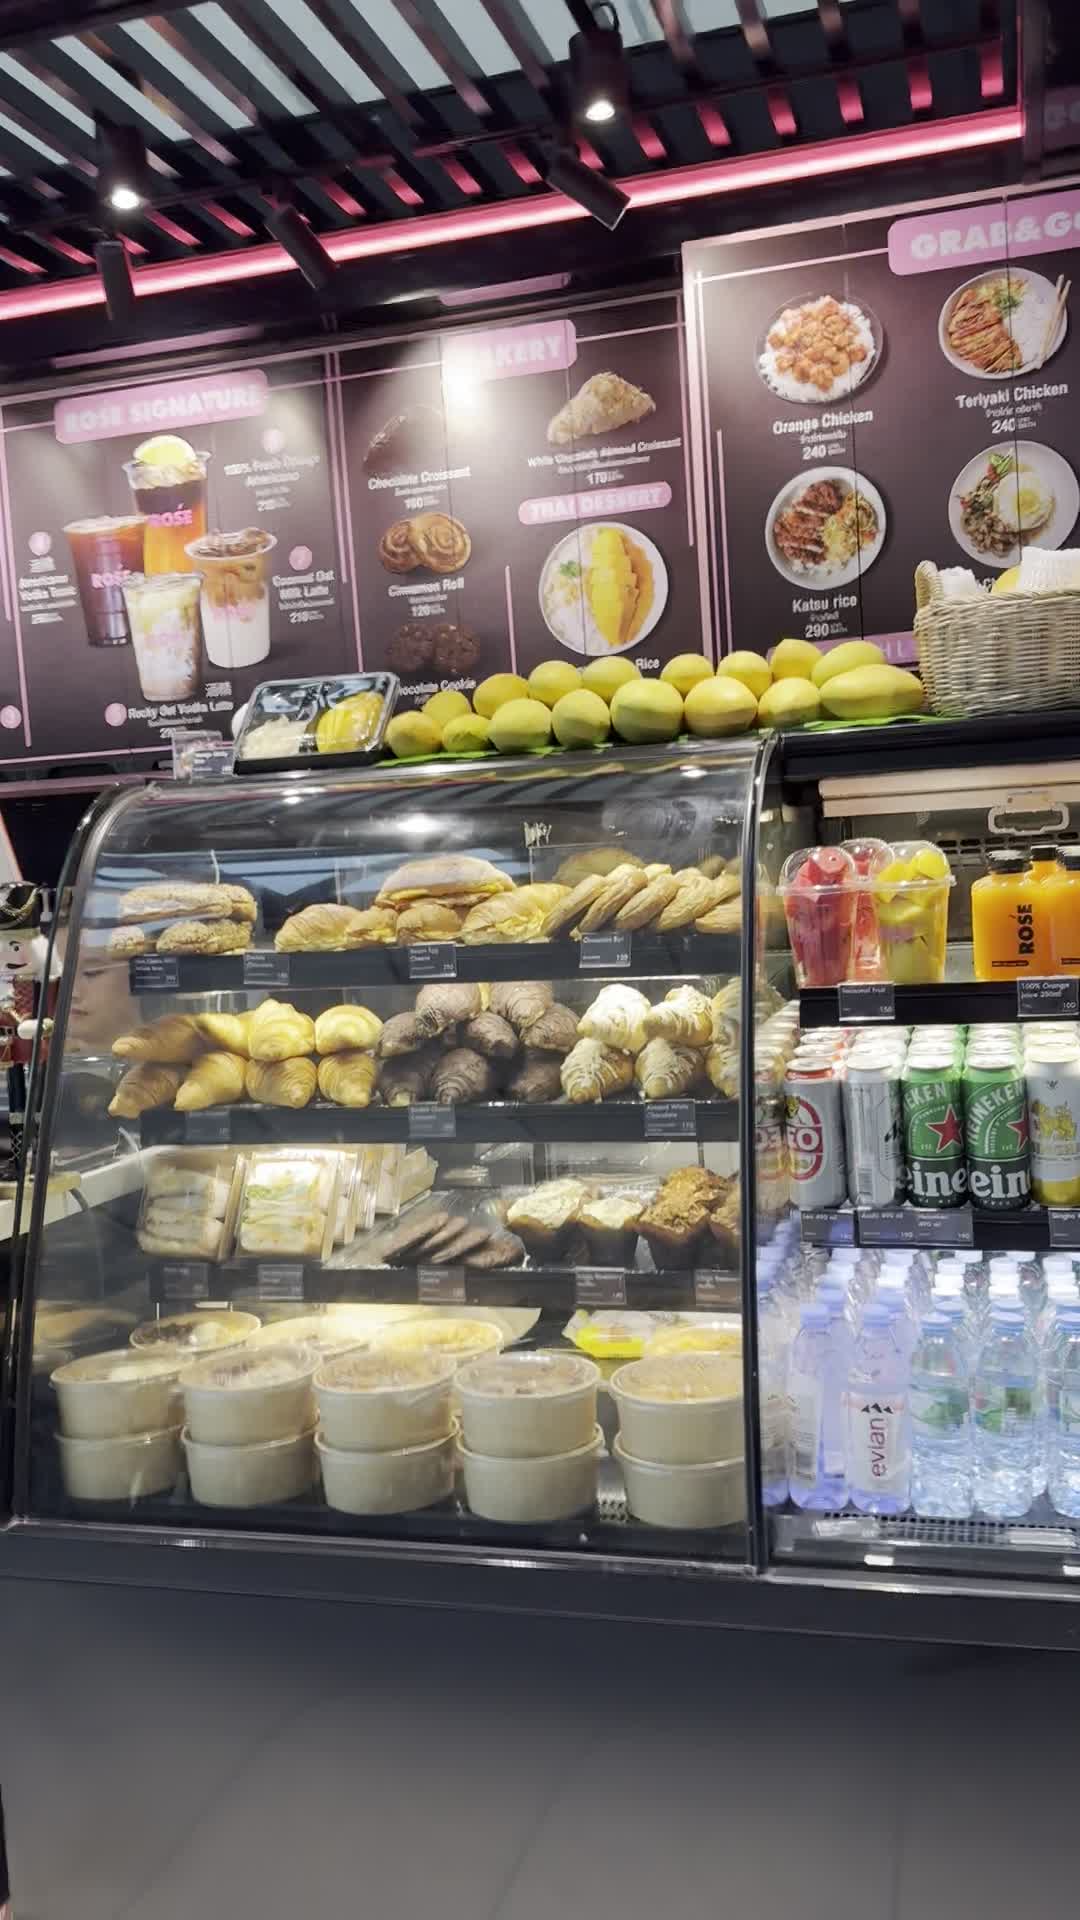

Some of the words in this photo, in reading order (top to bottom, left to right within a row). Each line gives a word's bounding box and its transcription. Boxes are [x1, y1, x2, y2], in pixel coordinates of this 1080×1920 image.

[494, 336, 560, 368] KERY
[128, 384, 260, 424] SIGNATURE
[955, 388, 1009, 408] Teriyaki
[1014, 383, 1068, 401] Chicken
[772, 418, 819, 434] Orange
[821, 410, 873, 427] Chicken
[991, 418, 1016, 434] 240
[802, 444, 826, 460] 240
[421, 466, 471, 483] Croissant
[578, 487, 663, 513] DESSERT
[442, 577, 465, 591] Roll
[792, 598, 829, 614] Katsu
[833, 595, 857, 609] rice
[805, 623, 829, 638] 290
[441, 677, 476, 692] Cookie
[128, 707, 158, 719] Rocky
[1021, 982, 1041, 990] 100%
[1042, 982, 1070, 990] Orange
[866, 1418, 888, 1477] evian
